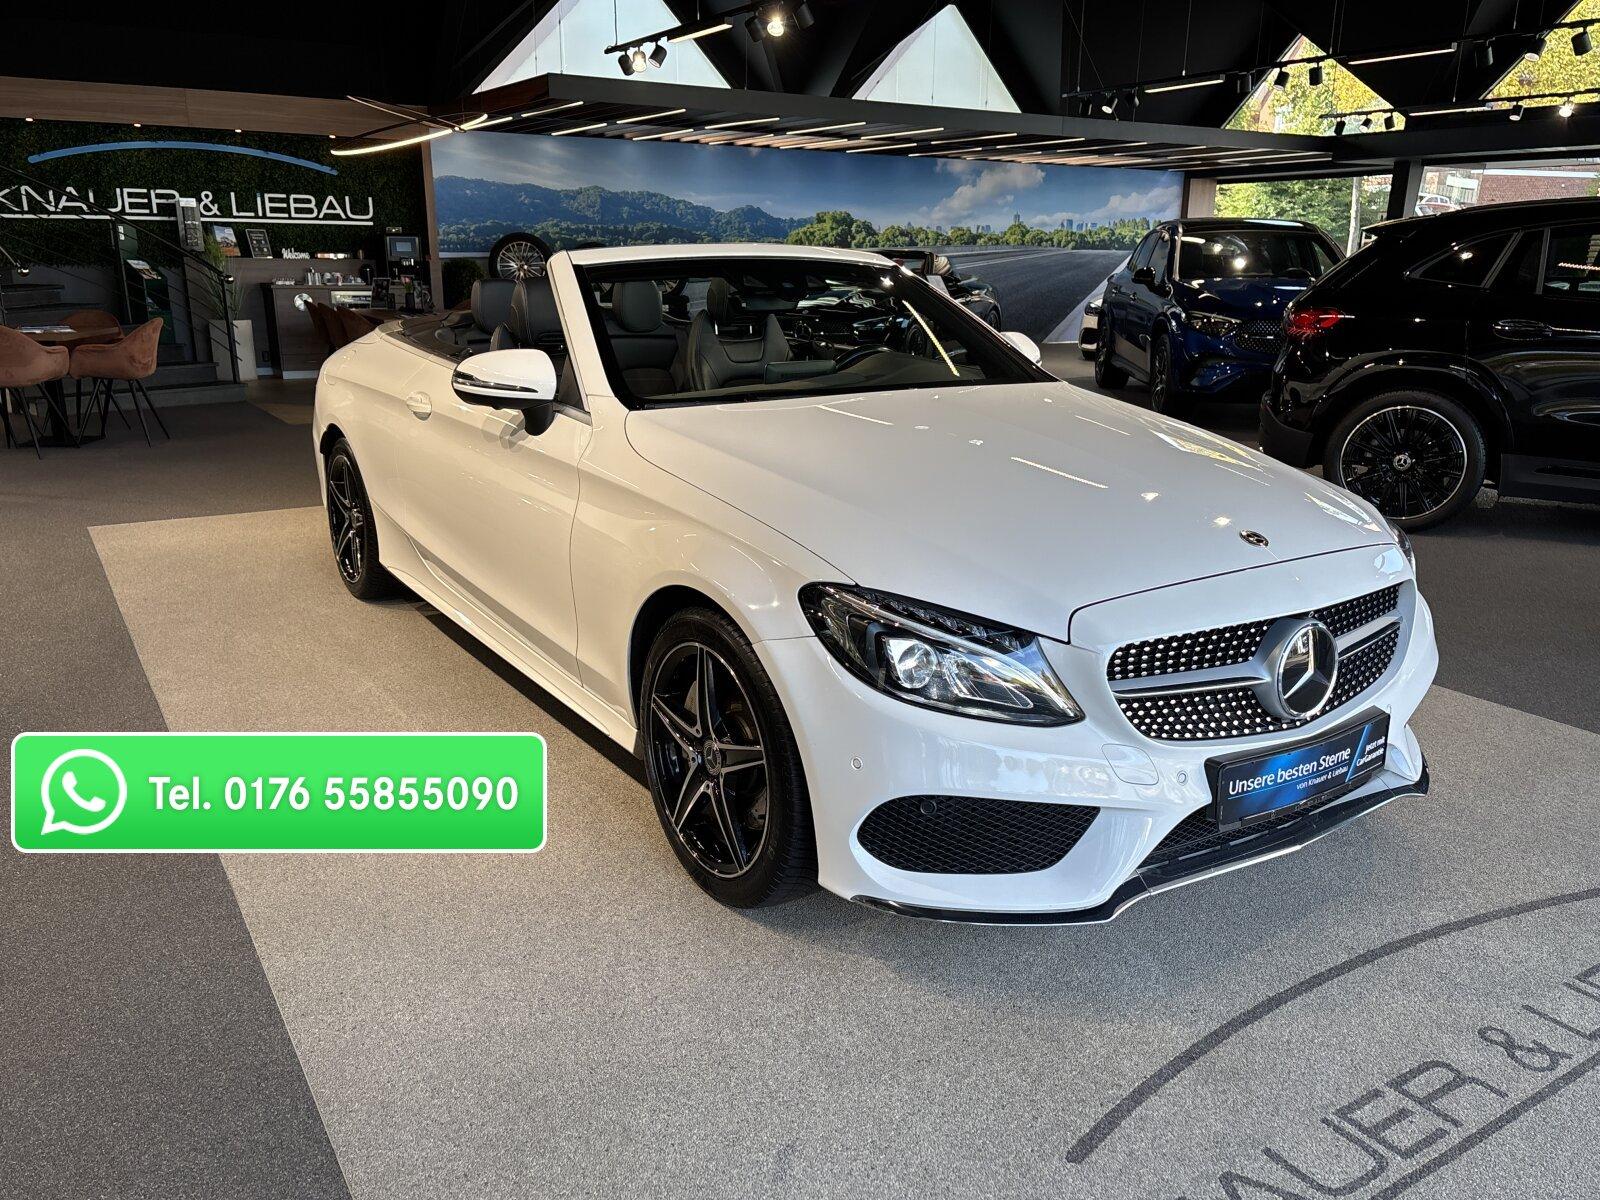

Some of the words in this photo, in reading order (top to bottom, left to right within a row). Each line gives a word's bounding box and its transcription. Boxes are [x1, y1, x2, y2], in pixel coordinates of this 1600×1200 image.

[200, 191, 221, 216] &
[230, 191, 374, 220] LIEBAU
[1229, 771, 1275, 795] Unsere
[1276, 760, 1317, 783] besten
[1318, 747, 1351, 770] Sterne
[1296, 779, 1309, 790] von
[1308, 774, 1327, 787] Knauer
[1327, 771, 1332, 780] &
[1332, 765, 1350, 776] Liebau
[1477, 1025, 1574, 1073] &
